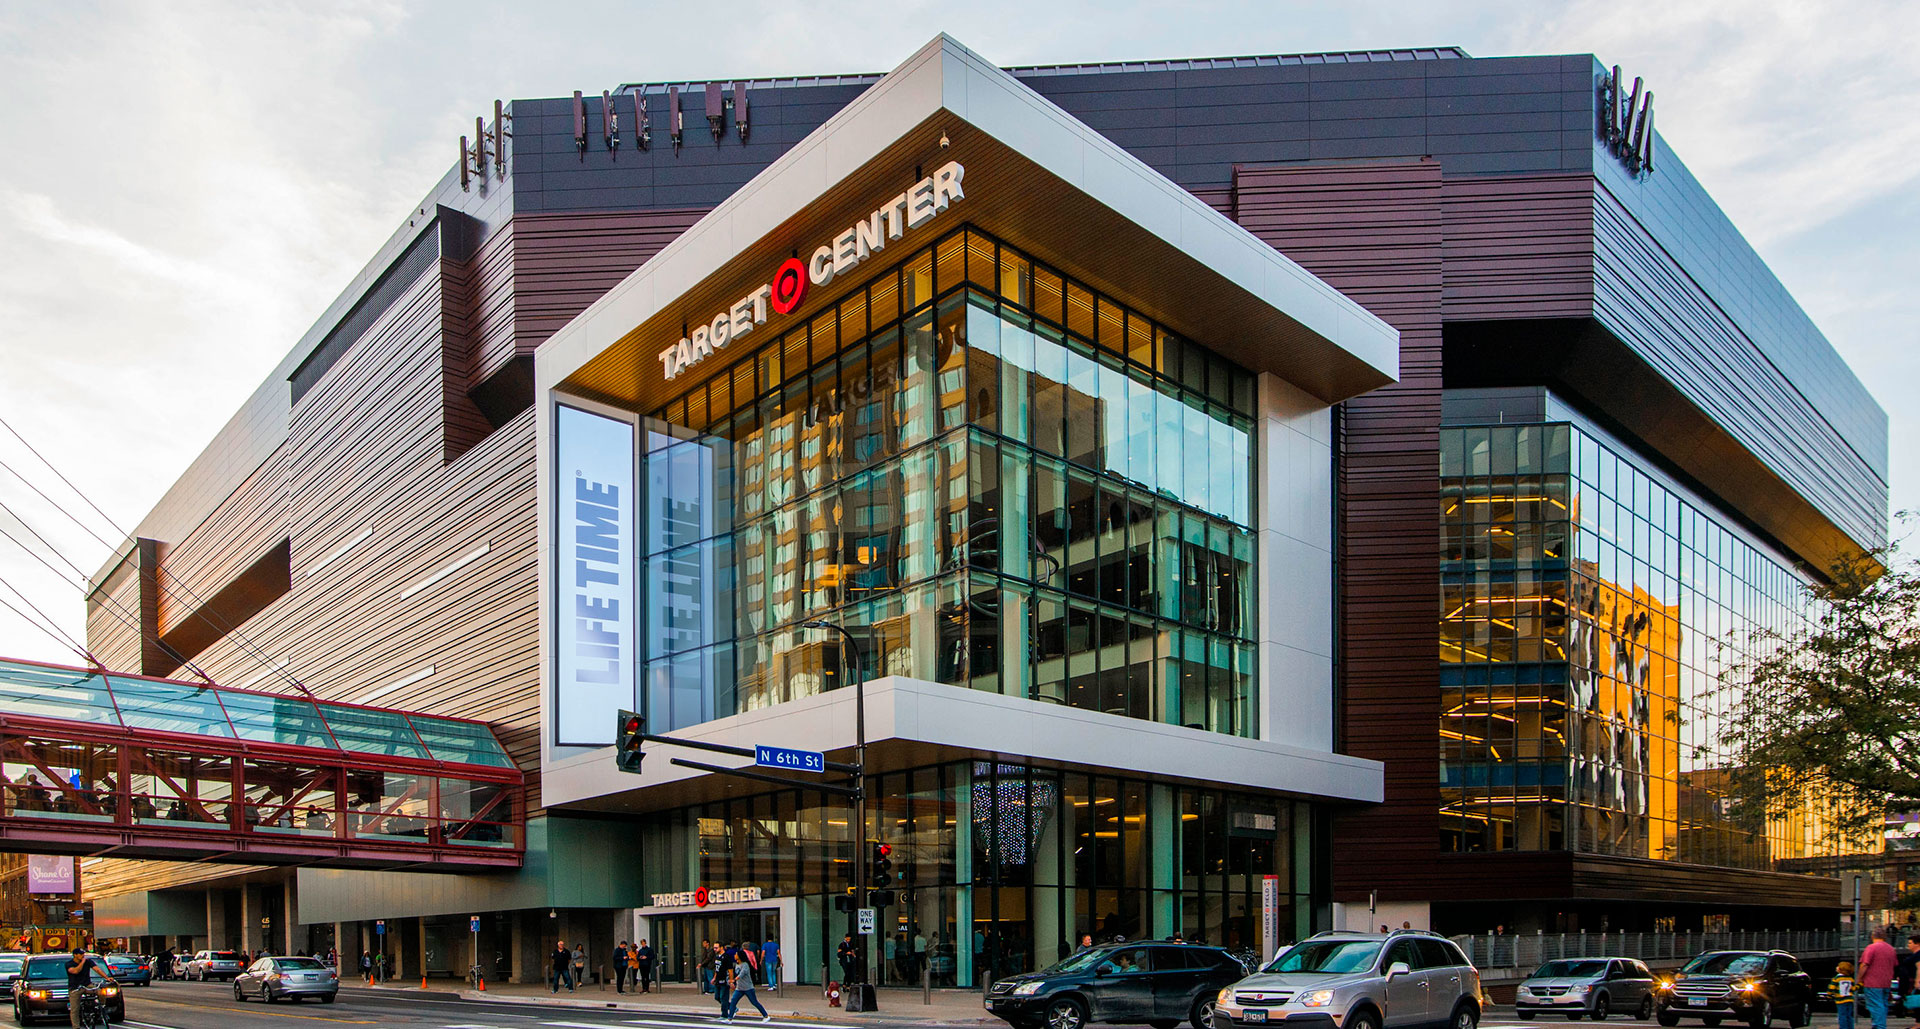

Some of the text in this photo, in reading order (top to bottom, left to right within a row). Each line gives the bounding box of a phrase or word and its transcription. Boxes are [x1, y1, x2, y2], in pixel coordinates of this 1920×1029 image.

[658, 160, 966, 381] TARGET CENTER
[575, 594, 620, 684] LIFE
[761, 749, 819, 767] N 6th St
[32, 866, 58, 880] Shane
[651, 886, 761, 907] TARGET CENTER
